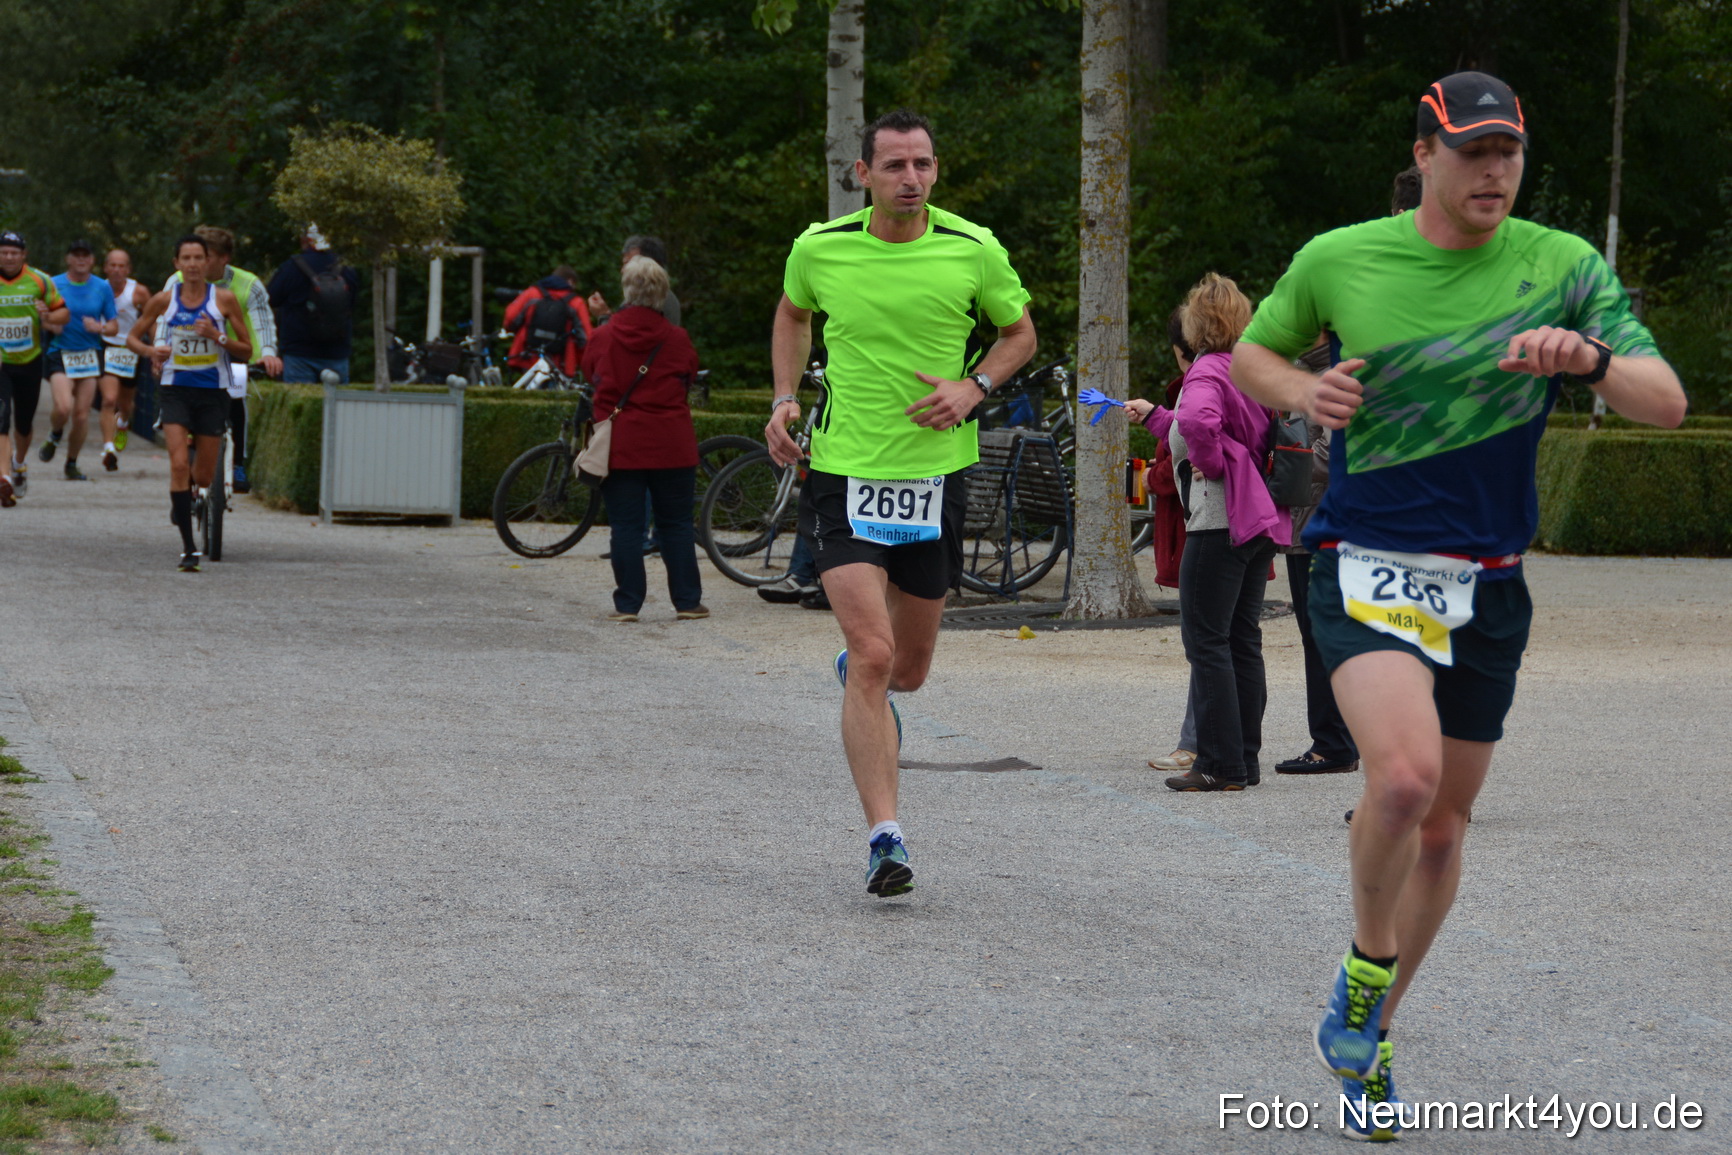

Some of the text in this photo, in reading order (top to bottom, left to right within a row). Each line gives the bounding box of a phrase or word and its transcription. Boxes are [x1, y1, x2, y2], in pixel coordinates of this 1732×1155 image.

[0, 326, 29, 339] 2809
[180, 339, 208, 354] 371
[857, 485, 933, 520] 2691
[867, 526, 920, 541] Reinhard
[1371, 566, 1448, 615] 286
